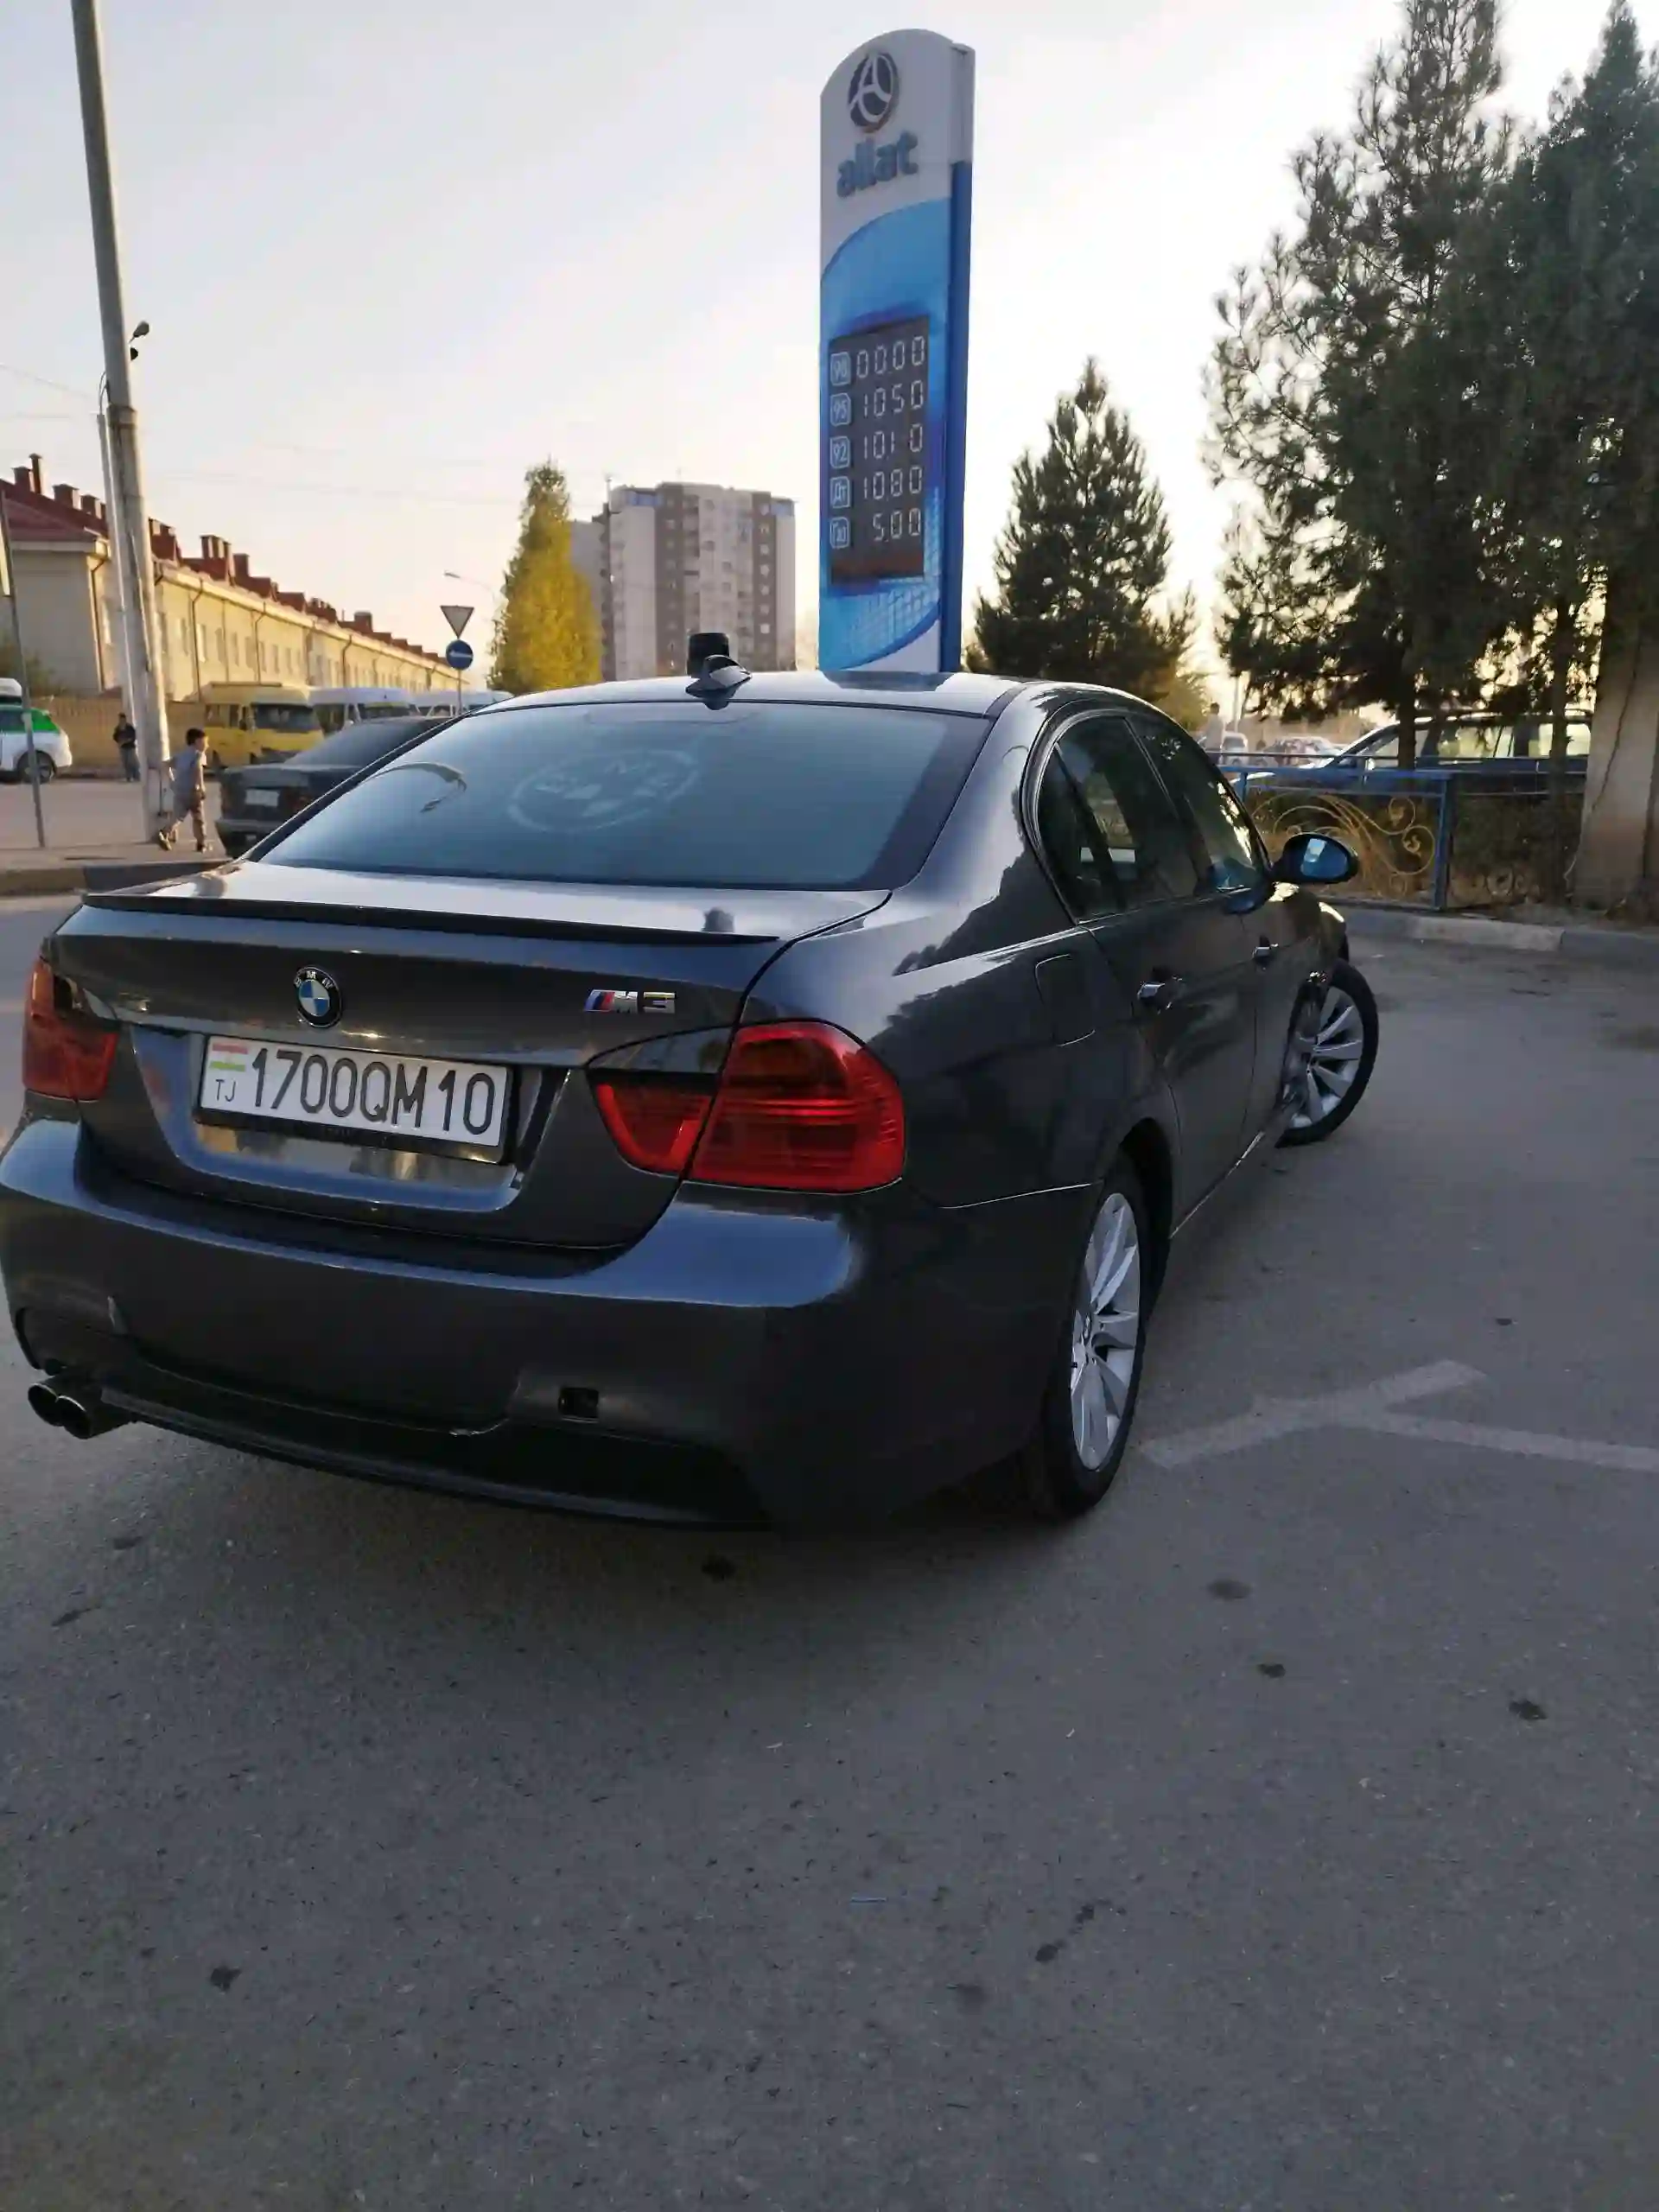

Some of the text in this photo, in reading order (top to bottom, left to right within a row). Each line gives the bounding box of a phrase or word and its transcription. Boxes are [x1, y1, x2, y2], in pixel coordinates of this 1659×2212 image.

[833, 442, 849, 462] 92
[610, 990, 676, 1014] M3
[215, 1078, 236, 1103] TJ
